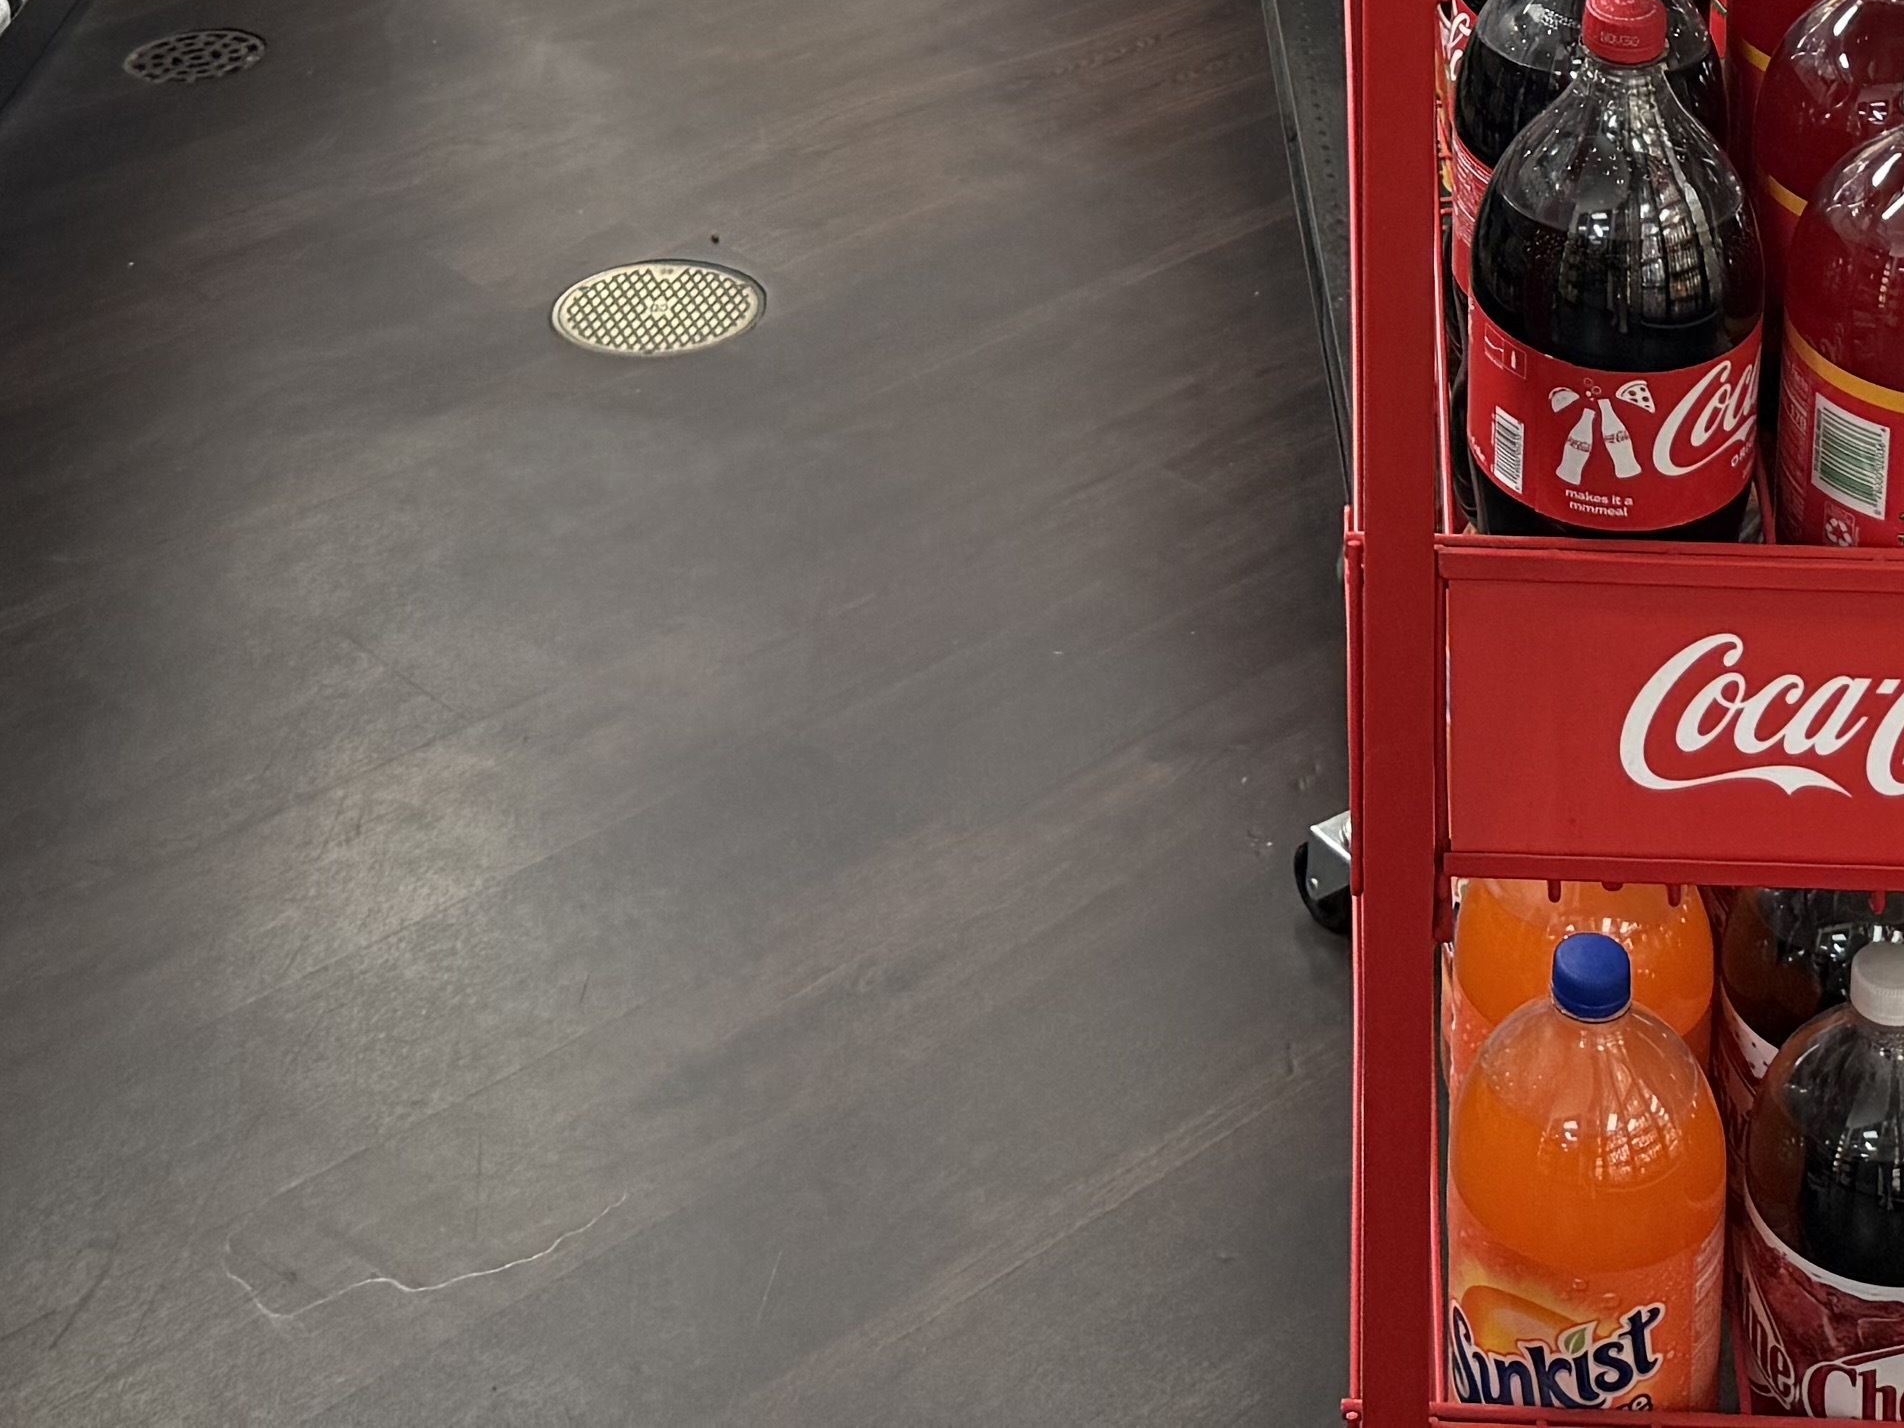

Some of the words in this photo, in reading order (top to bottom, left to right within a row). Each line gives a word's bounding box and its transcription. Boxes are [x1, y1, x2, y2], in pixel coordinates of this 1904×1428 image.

[1565, 487, 1609, 506] makes
[1611, 493, 1622, 507] it
[1569, 500, 1628, 518] mmmeal
[1451, 1302, 1669, 1410] Sunkist
